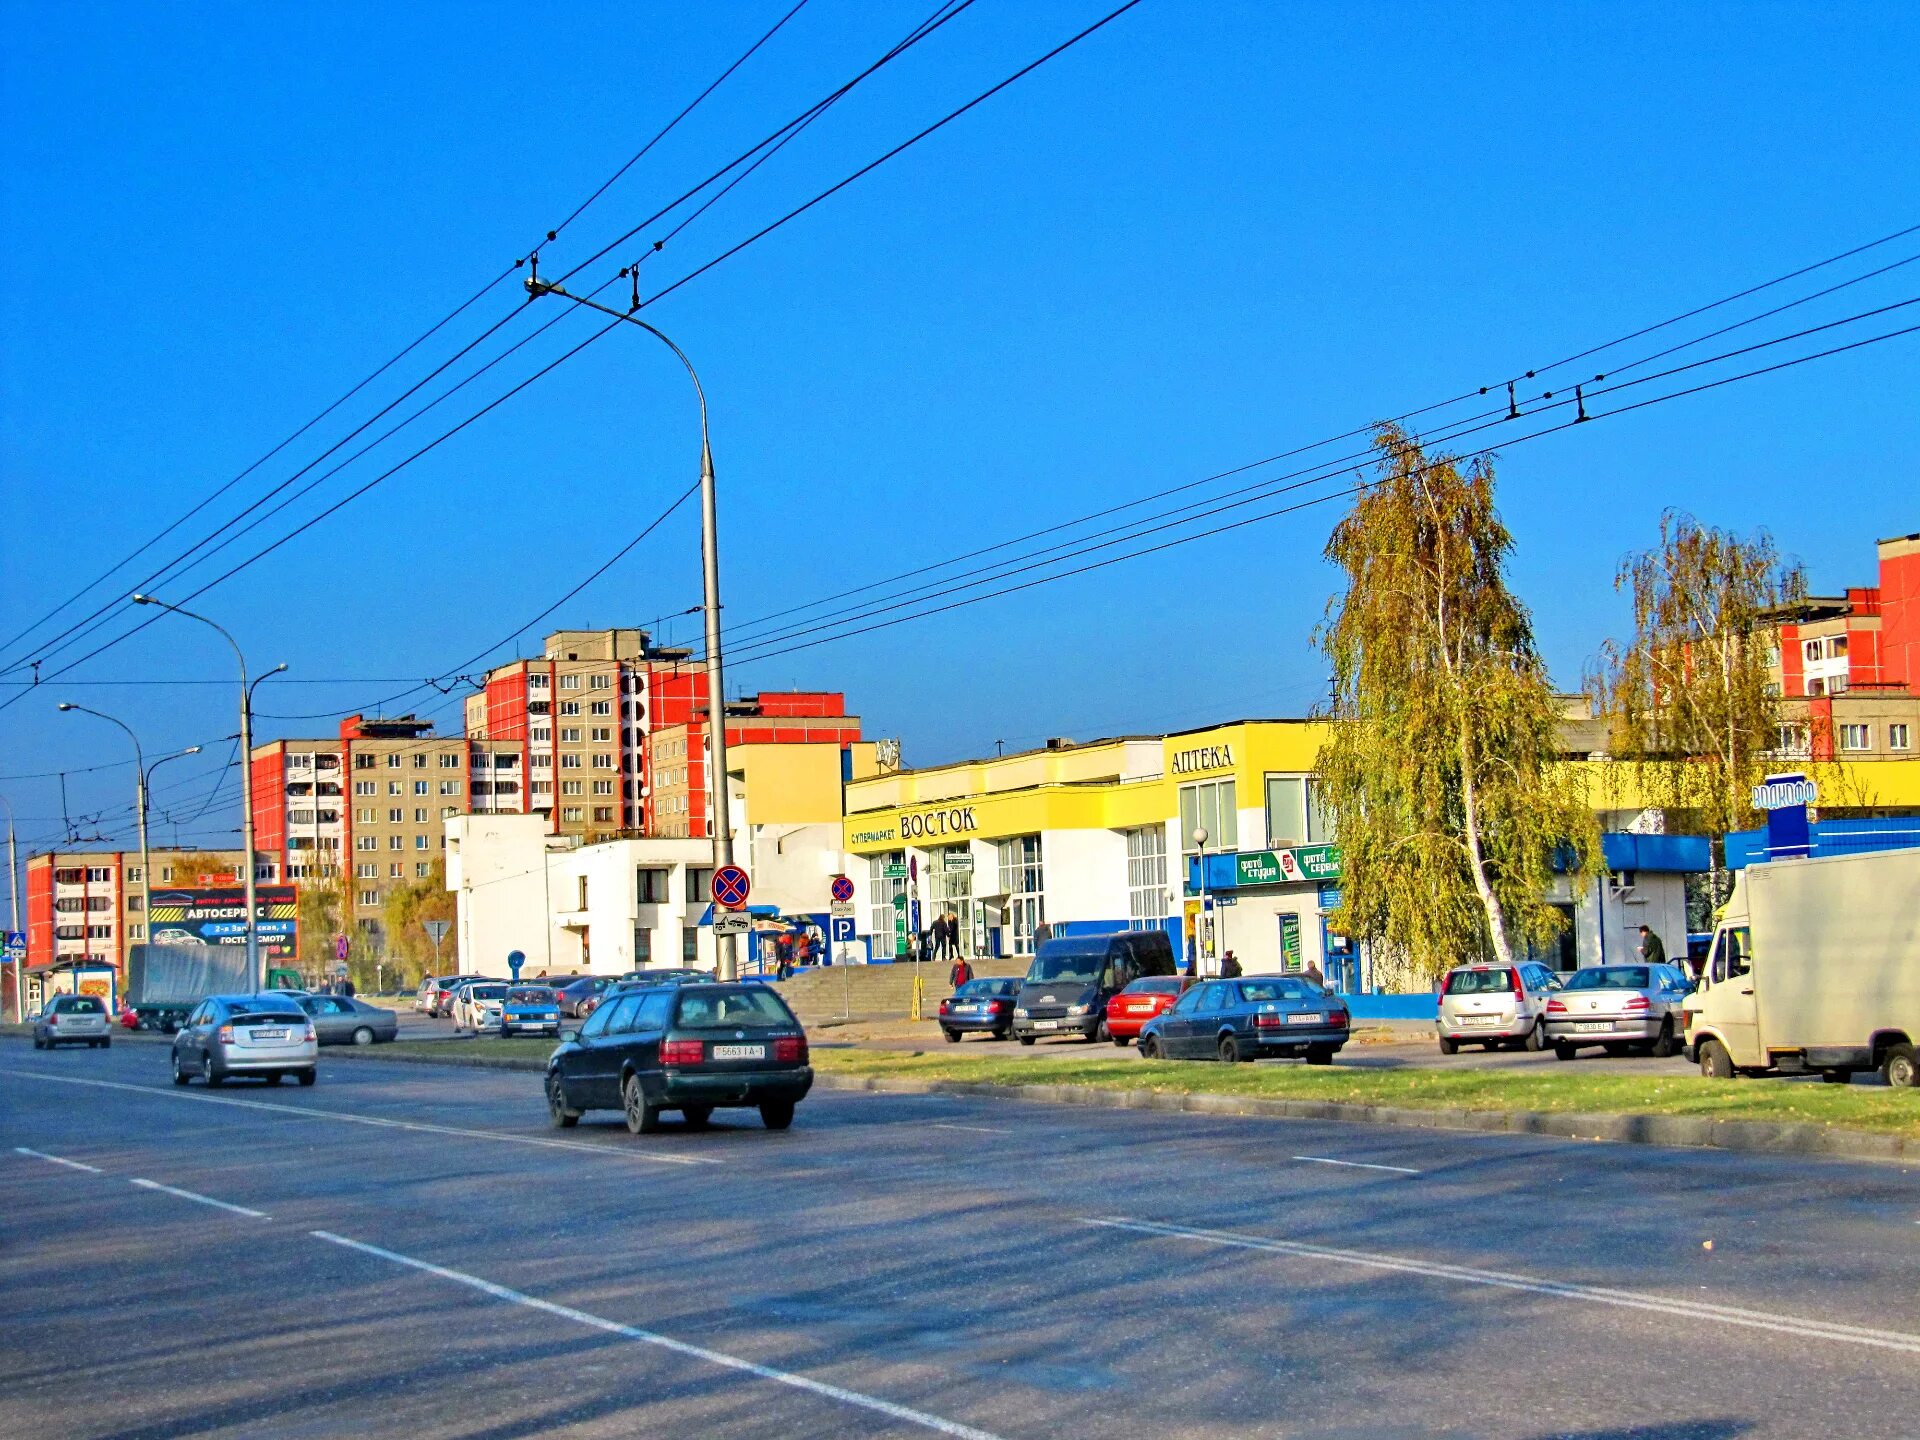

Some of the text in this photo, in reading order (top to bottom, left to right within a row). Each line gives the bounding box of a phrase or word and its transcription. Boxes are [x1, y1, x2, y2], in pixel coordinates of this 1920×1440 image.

[1171, 745, 1234, 774] АПТЕКА
[900, 807, 977, 840] ВОСТОК
[187, 908, 265, 918] АВТОСЕРВС
[221, 935, 286, 943] ГОСТЕСМОТР
[722, 1047, 741, 1056] 5663
